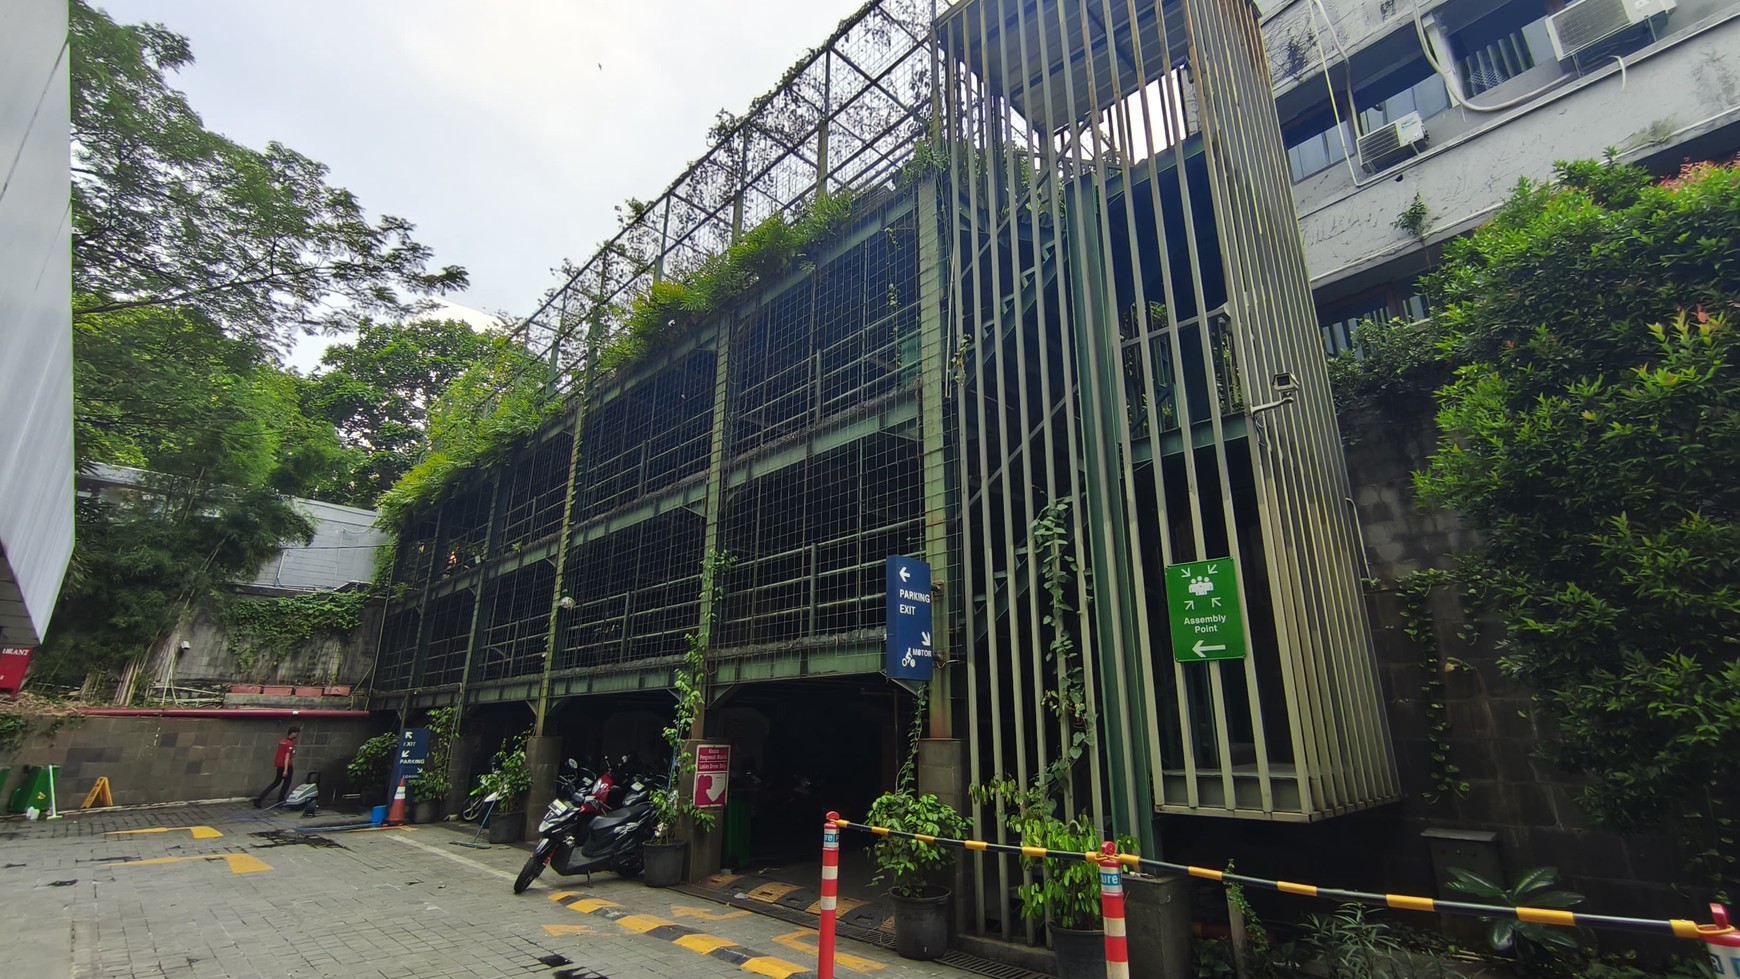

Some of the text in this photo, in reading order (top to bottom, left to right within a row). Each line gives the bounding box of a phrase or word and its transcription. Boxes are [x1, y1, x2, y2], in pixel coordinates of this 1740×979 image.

[900, 589, 931, 603] PARKING
[900, 604, 916, 616] EXIT
[1184, 614, 1226, 625] Assembly
[1194, 625, 1218, 634] Point
[912, 648, 932, 658] MOTOR
